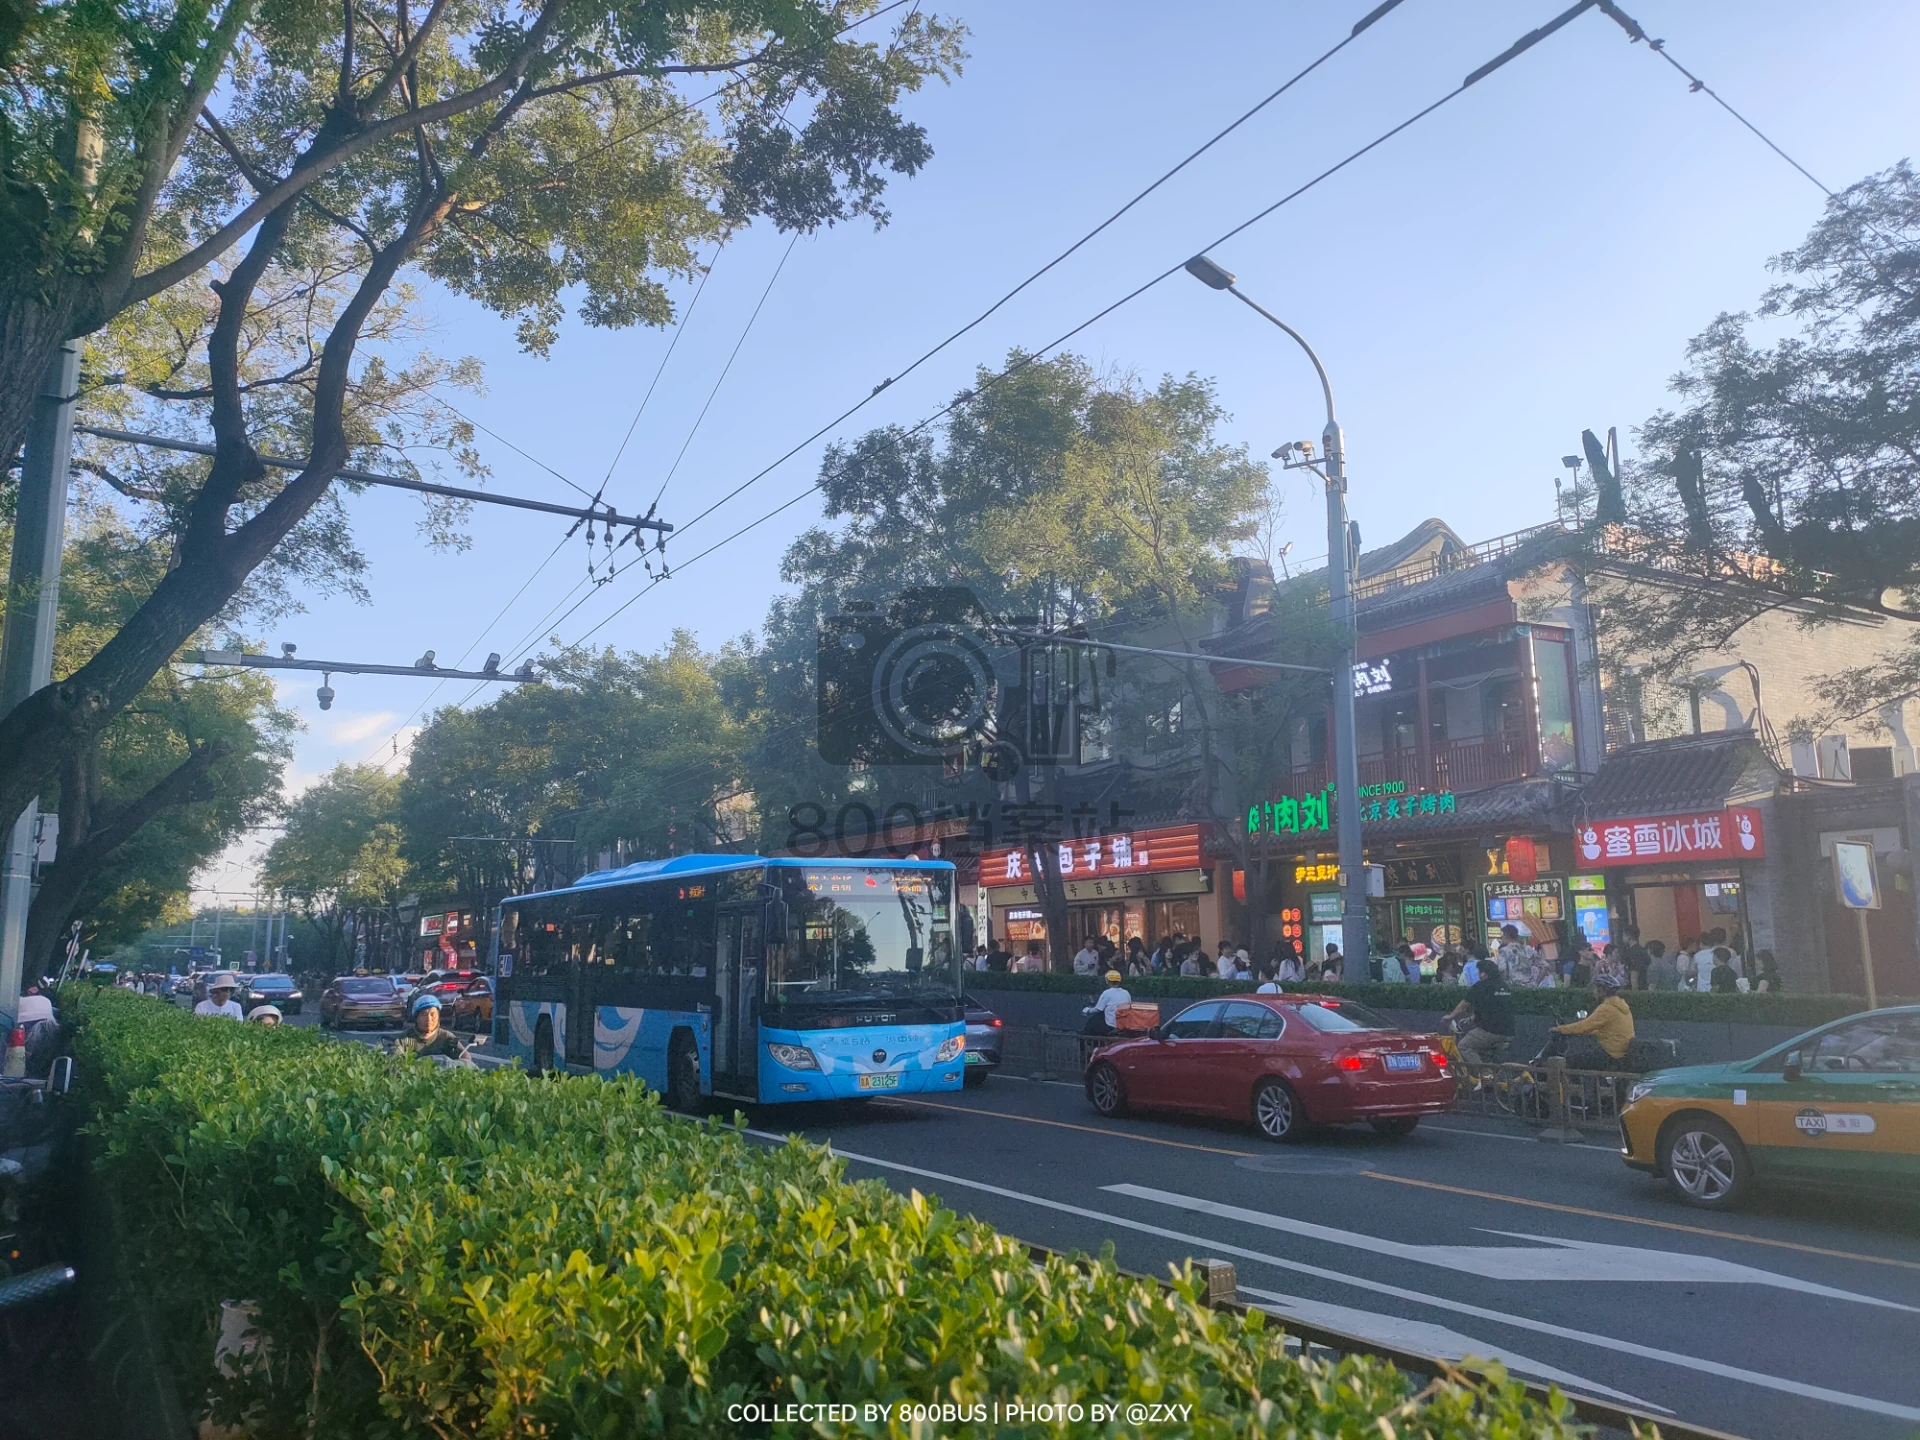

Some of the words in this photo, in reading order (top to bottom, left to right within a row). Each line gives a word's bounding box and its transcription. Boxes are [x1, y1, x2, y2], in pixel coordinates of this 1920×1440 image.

[1359, 784, 1380, 798] INCE
[1604, 816, 1723, 858] 蜜雪冰城
[998, 837, 1132, 879] 庆包子铺
[1798, 1118, 1824, 1127] TAXI
